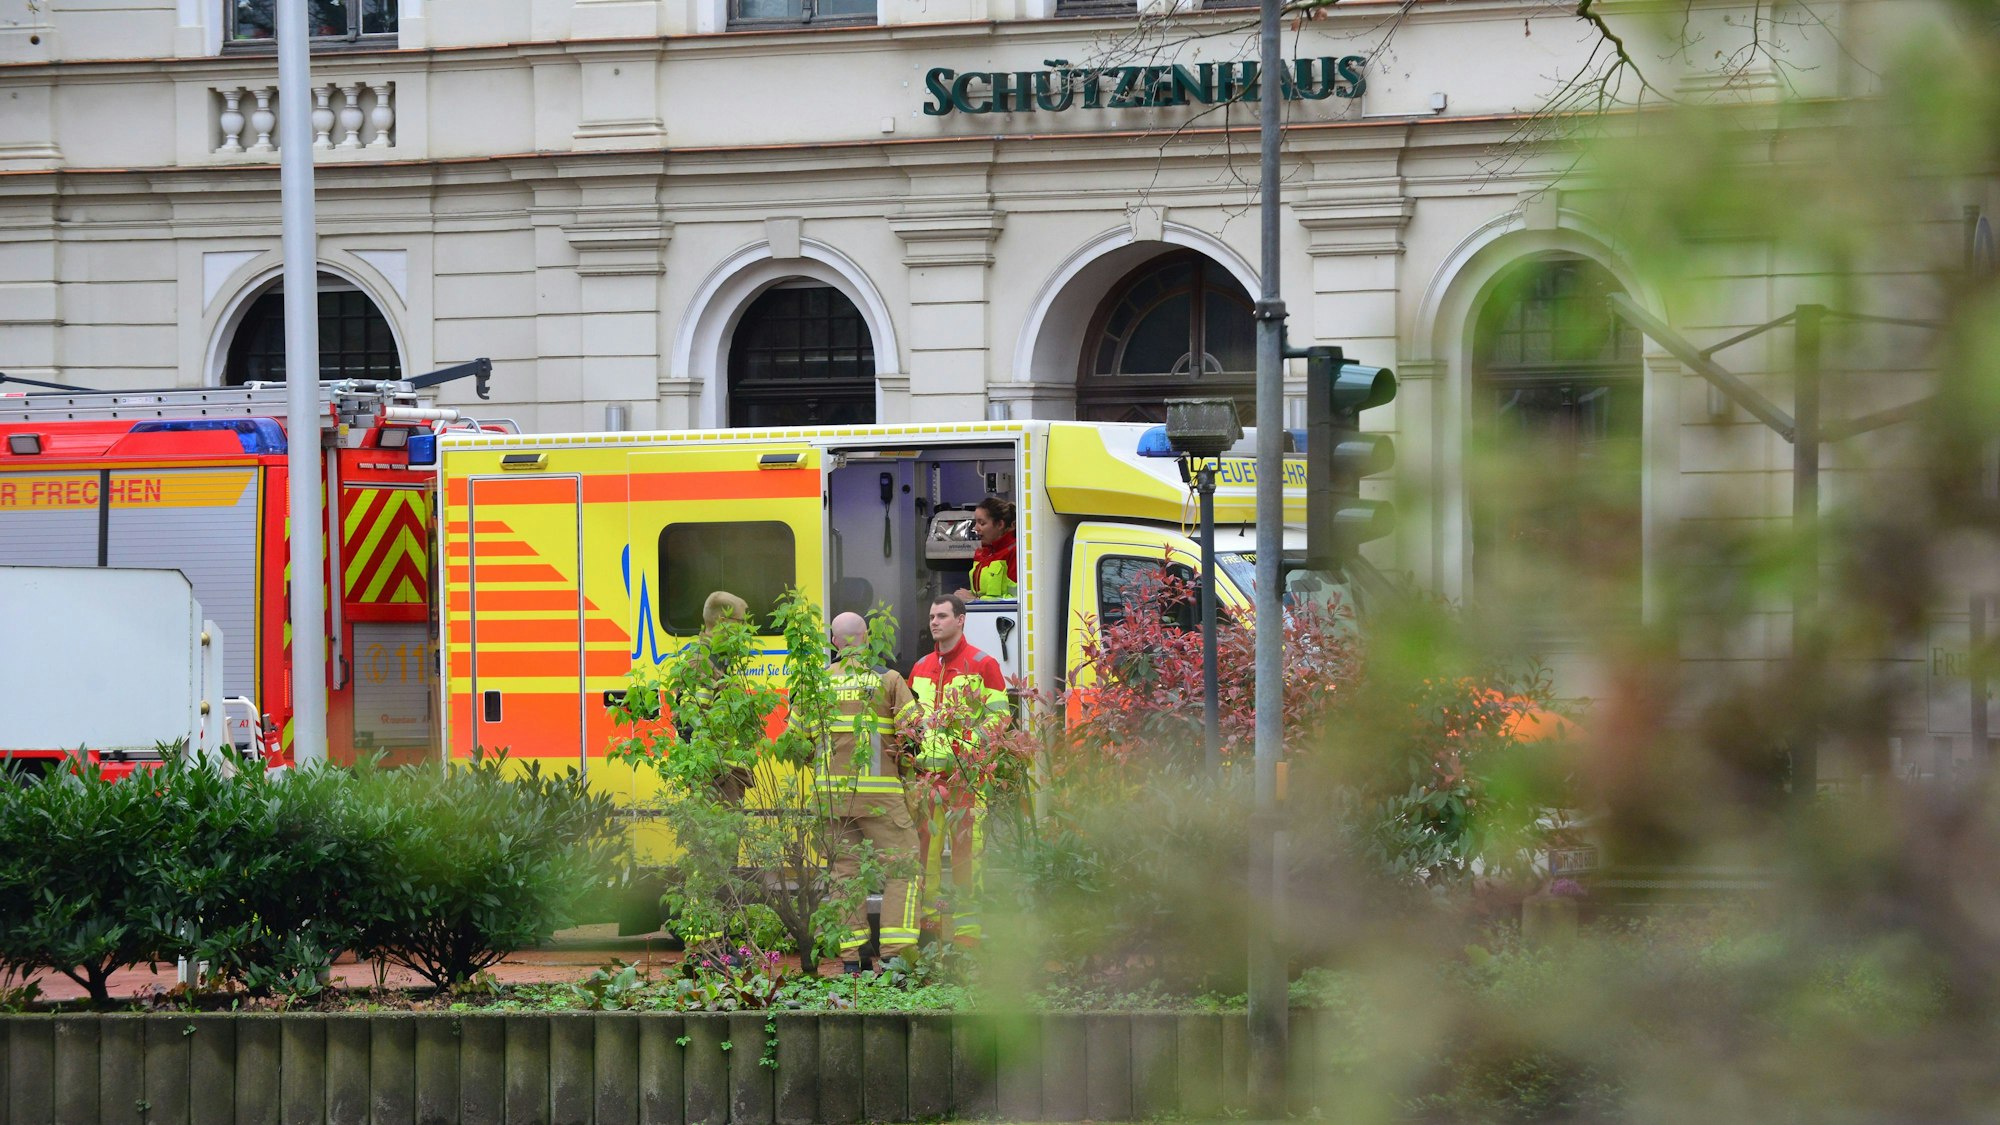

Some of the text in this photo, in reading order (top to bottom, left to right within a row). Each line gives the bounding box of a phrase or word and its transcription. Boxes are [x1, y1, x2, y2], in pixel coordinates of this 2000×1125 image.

[924, 56, 1366, 115] SCHÜTZENHAUS
[1207, 461, 1307, 485] FEUEHR
[31, 479, 161, 505] FRECHEN
[1242, 553, 1256, 562] RT
[395, 643, 432, 684] 11
[767, 663, 779, 676] Sie
[1932, 647, 1968, 676] FRE
